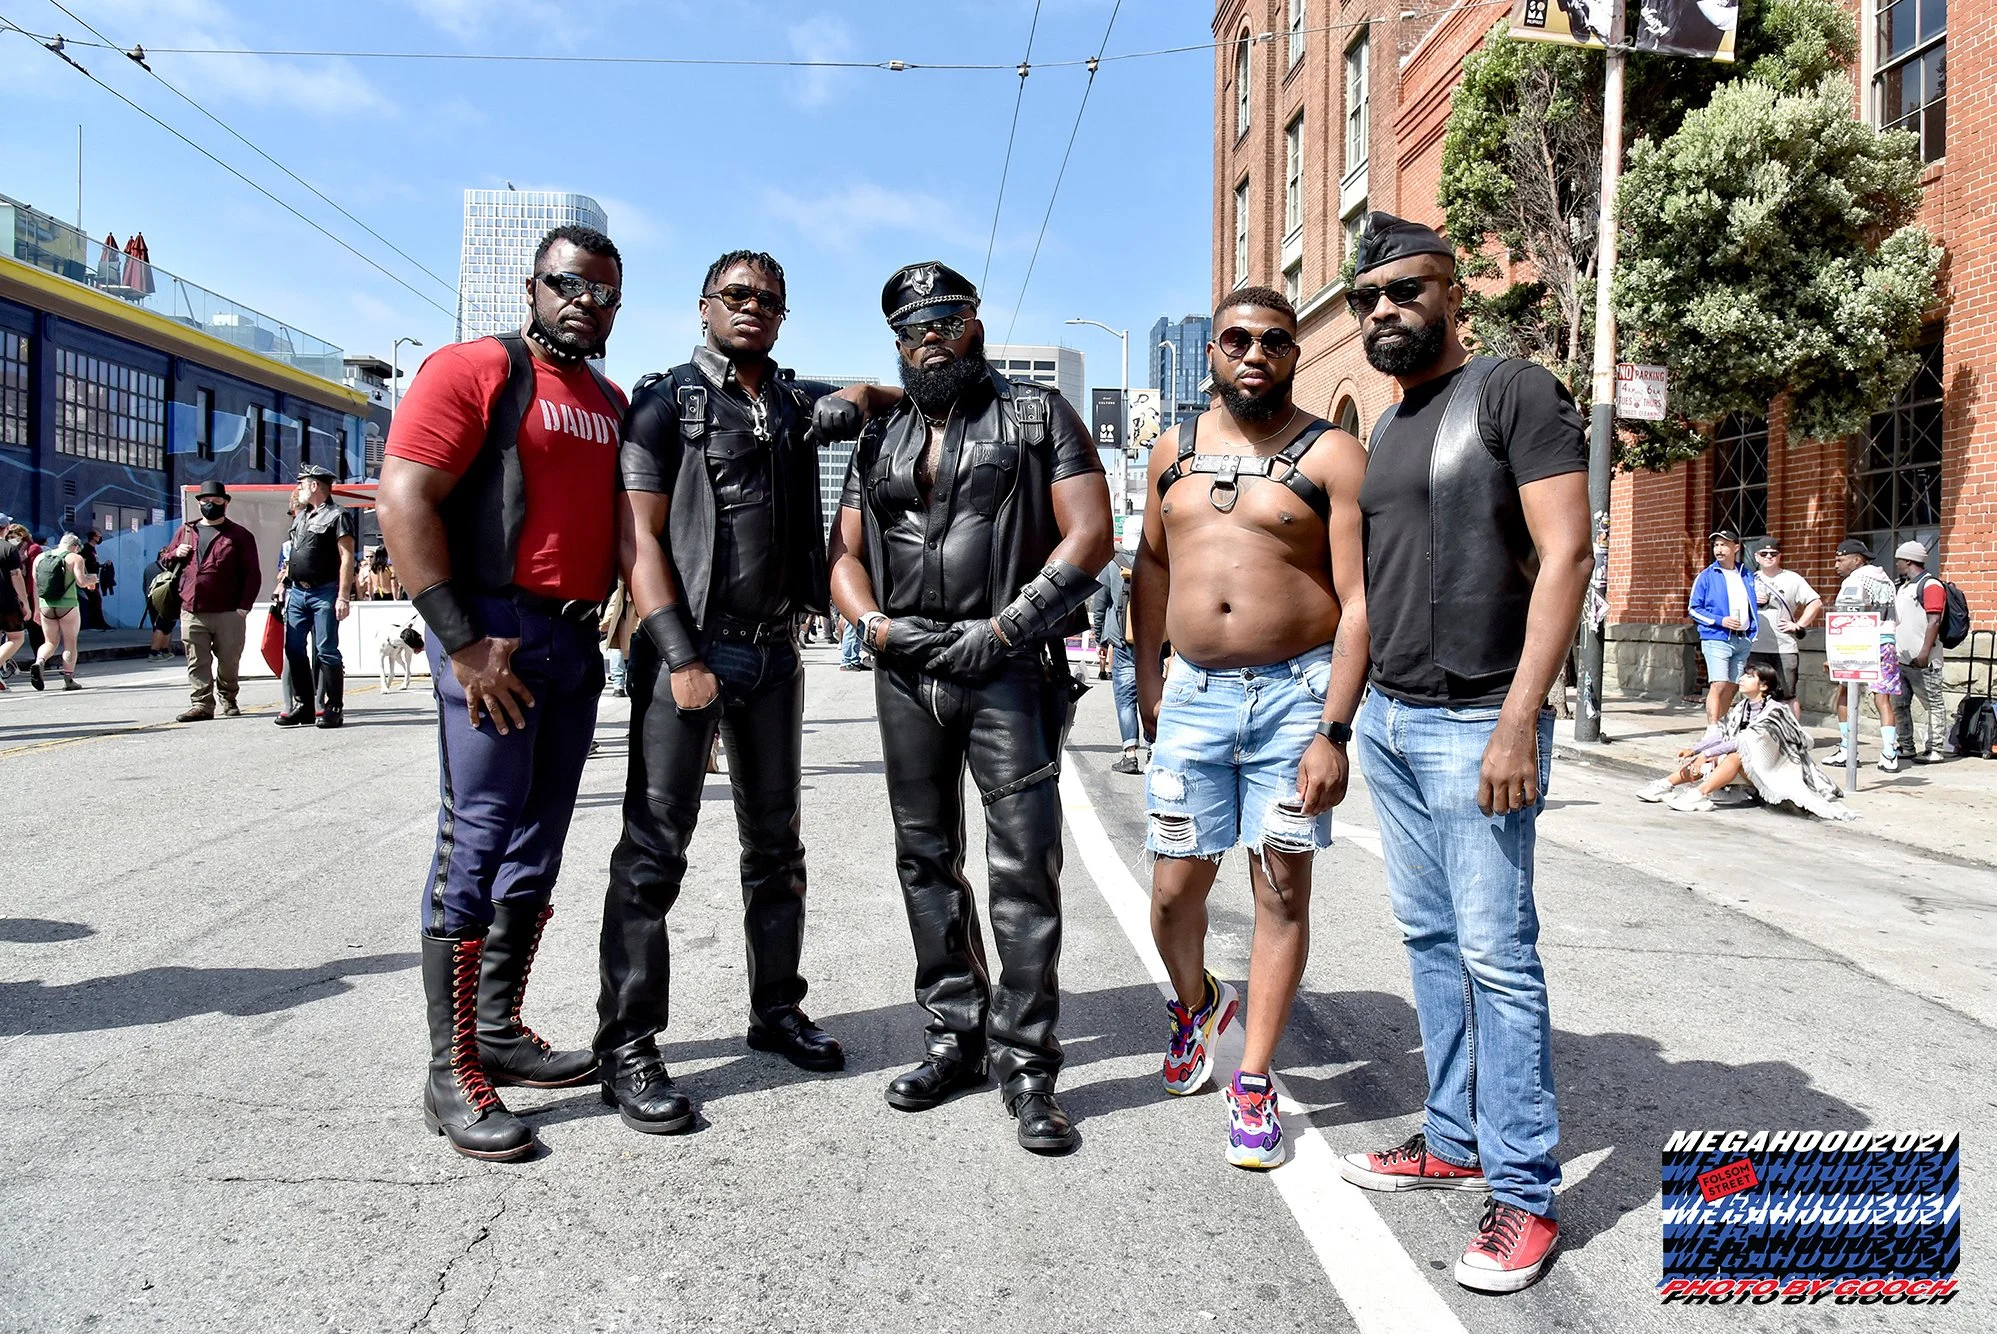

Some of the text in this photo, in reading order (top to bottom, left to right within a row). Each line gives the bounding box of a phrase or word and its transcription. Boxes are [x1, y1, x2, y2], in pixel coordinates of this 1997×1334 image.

[1618, 365, 1665, 382] NO PARKING
[1618, 396, 1632, 405] TUES
[539, 398, 620, 448] DADDY
